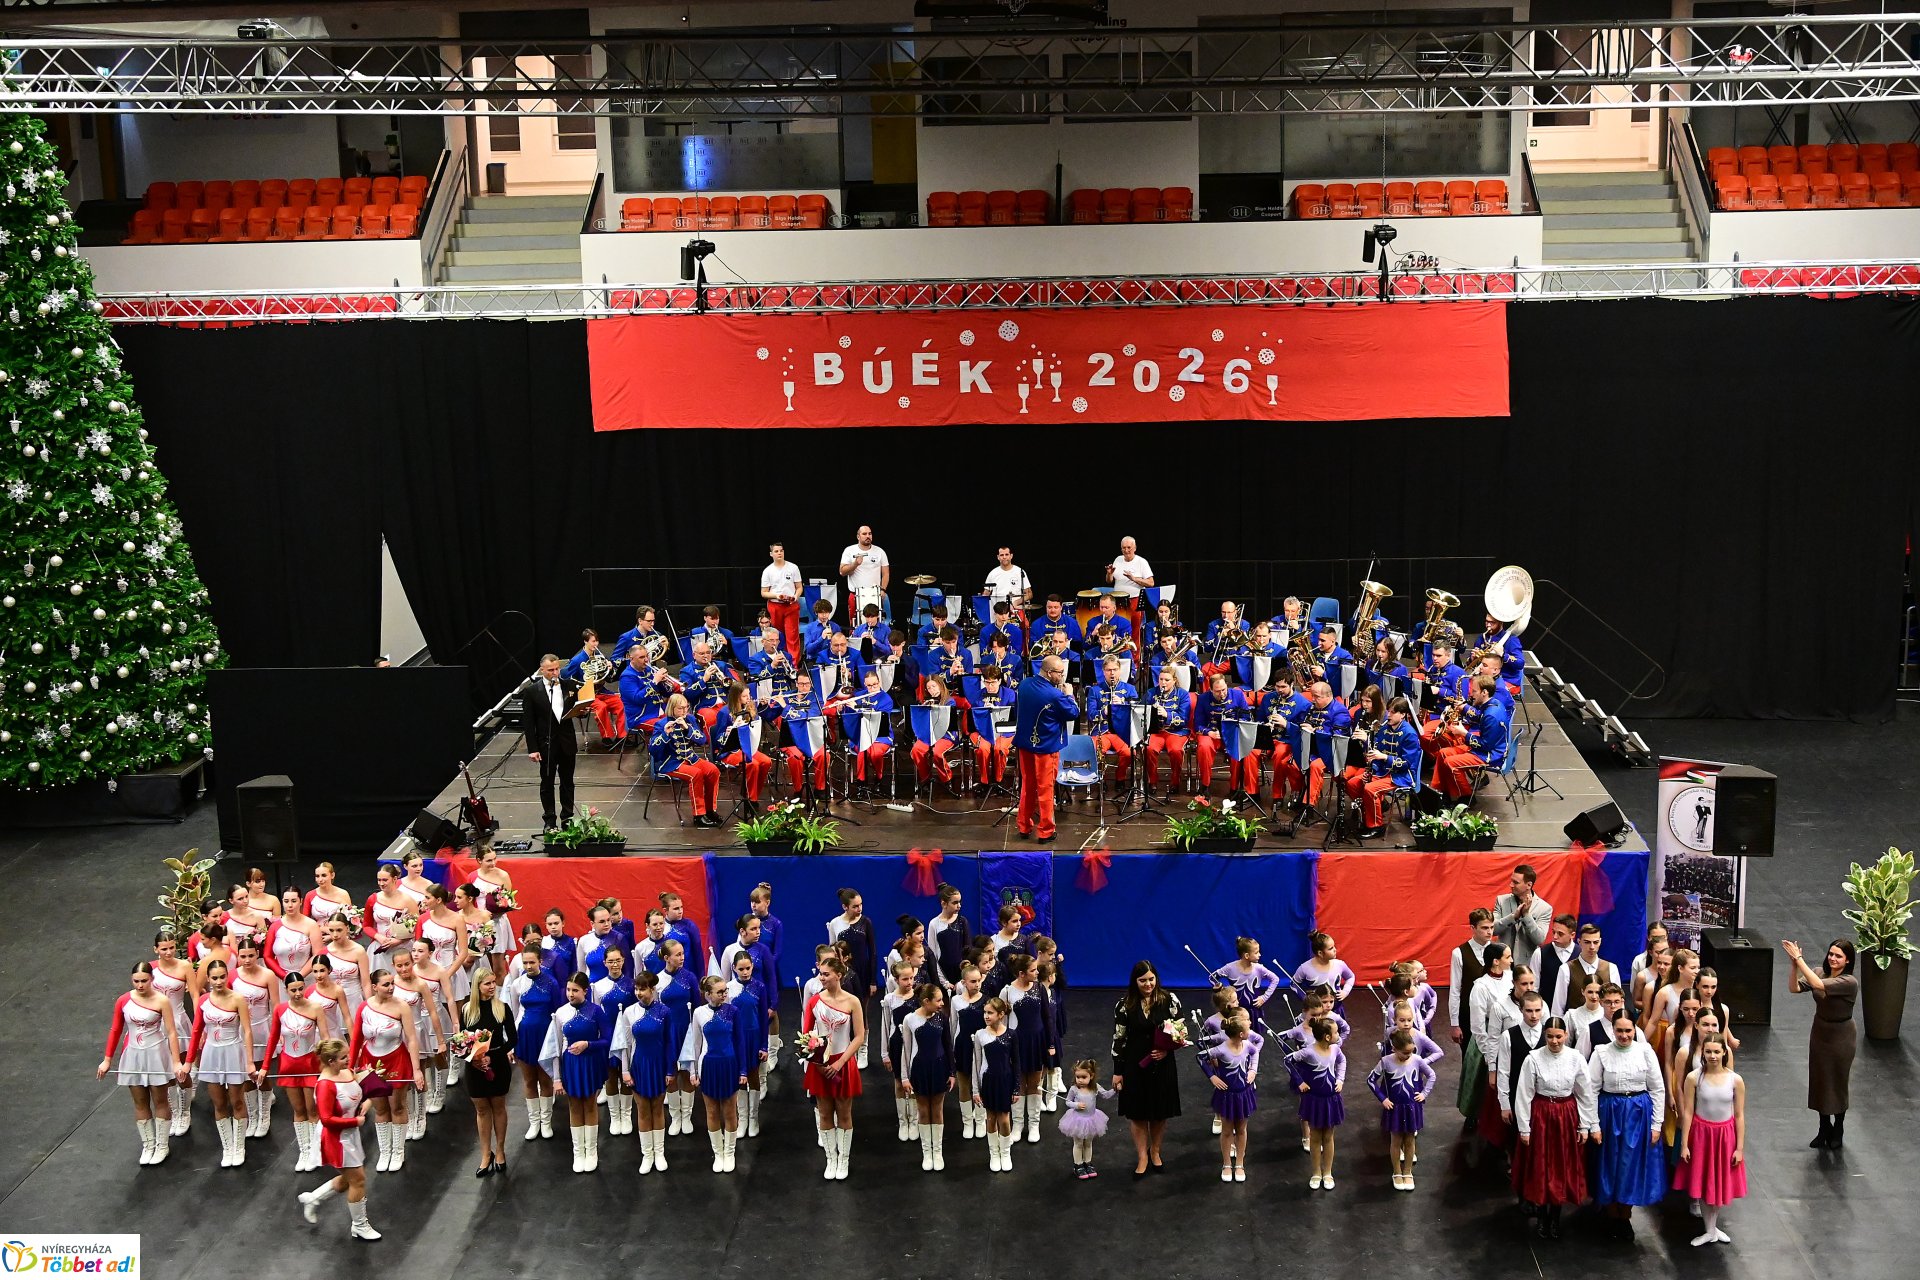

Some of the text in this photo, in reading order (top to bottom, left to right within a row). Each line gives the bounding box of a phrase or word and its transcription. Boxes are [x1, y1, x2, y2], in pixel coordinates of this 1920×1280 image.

[1232, 207, 1248, 217] BH
[1312, 206, 1328, 215] BH
[1392, 205, 1408, 214] BH
[1473, 203, 1489, 212] BH
[753, 217, 769, 226] BH
[813, 339, 1252, 394] BÚÉK 2026
